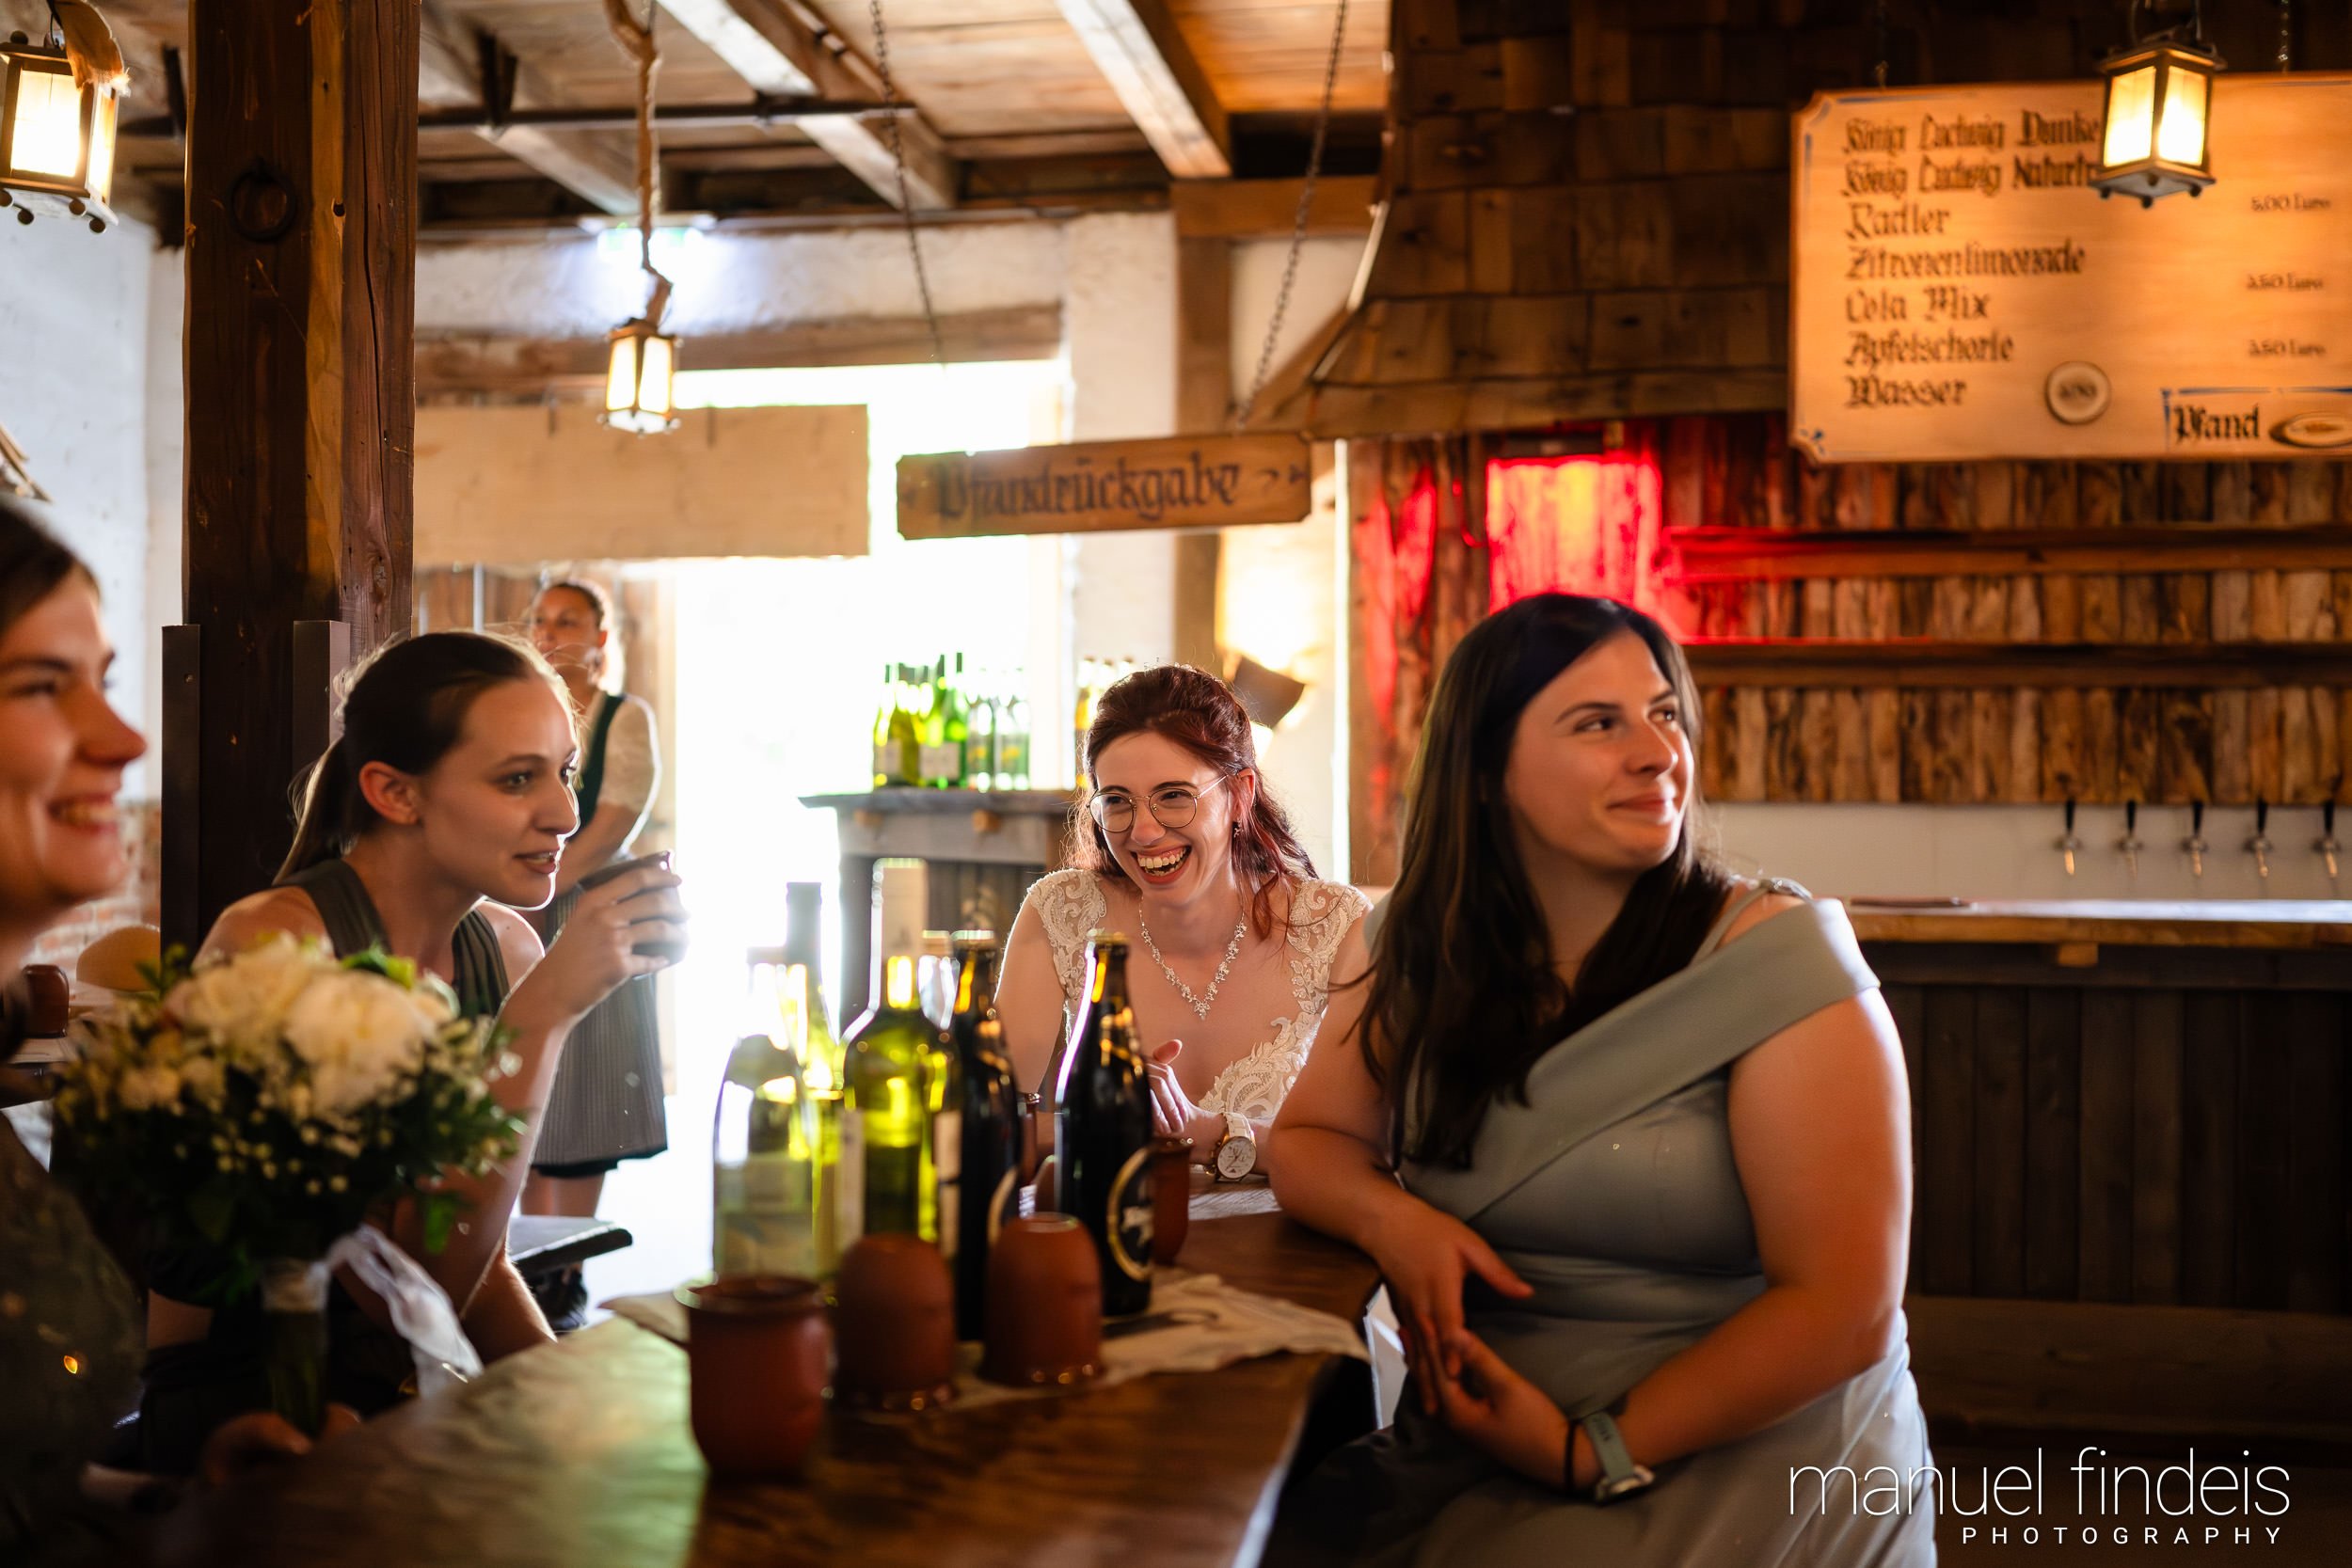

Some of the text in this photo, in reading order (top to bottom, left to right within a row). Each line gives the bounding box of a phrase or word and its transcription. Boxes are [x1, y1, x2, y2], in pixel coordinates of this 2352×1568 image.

[1919, 112, 2005, 154] Ludwig
[2016, 108, 2102, 148] Dunke
[1918, 154, 2002, 198] Ludwig
[1844, 200, 1950, 240] Radler
[1844, 237, 2086, 280] Zitronenlimonade
[1844, 283, 1991, 324] Cola Mix
[1844, 326, 2015, 372] Apfelschorle
[1844, 372, 1967, 409] Wasser
[2172, 402, 2261, 444] Pfand
